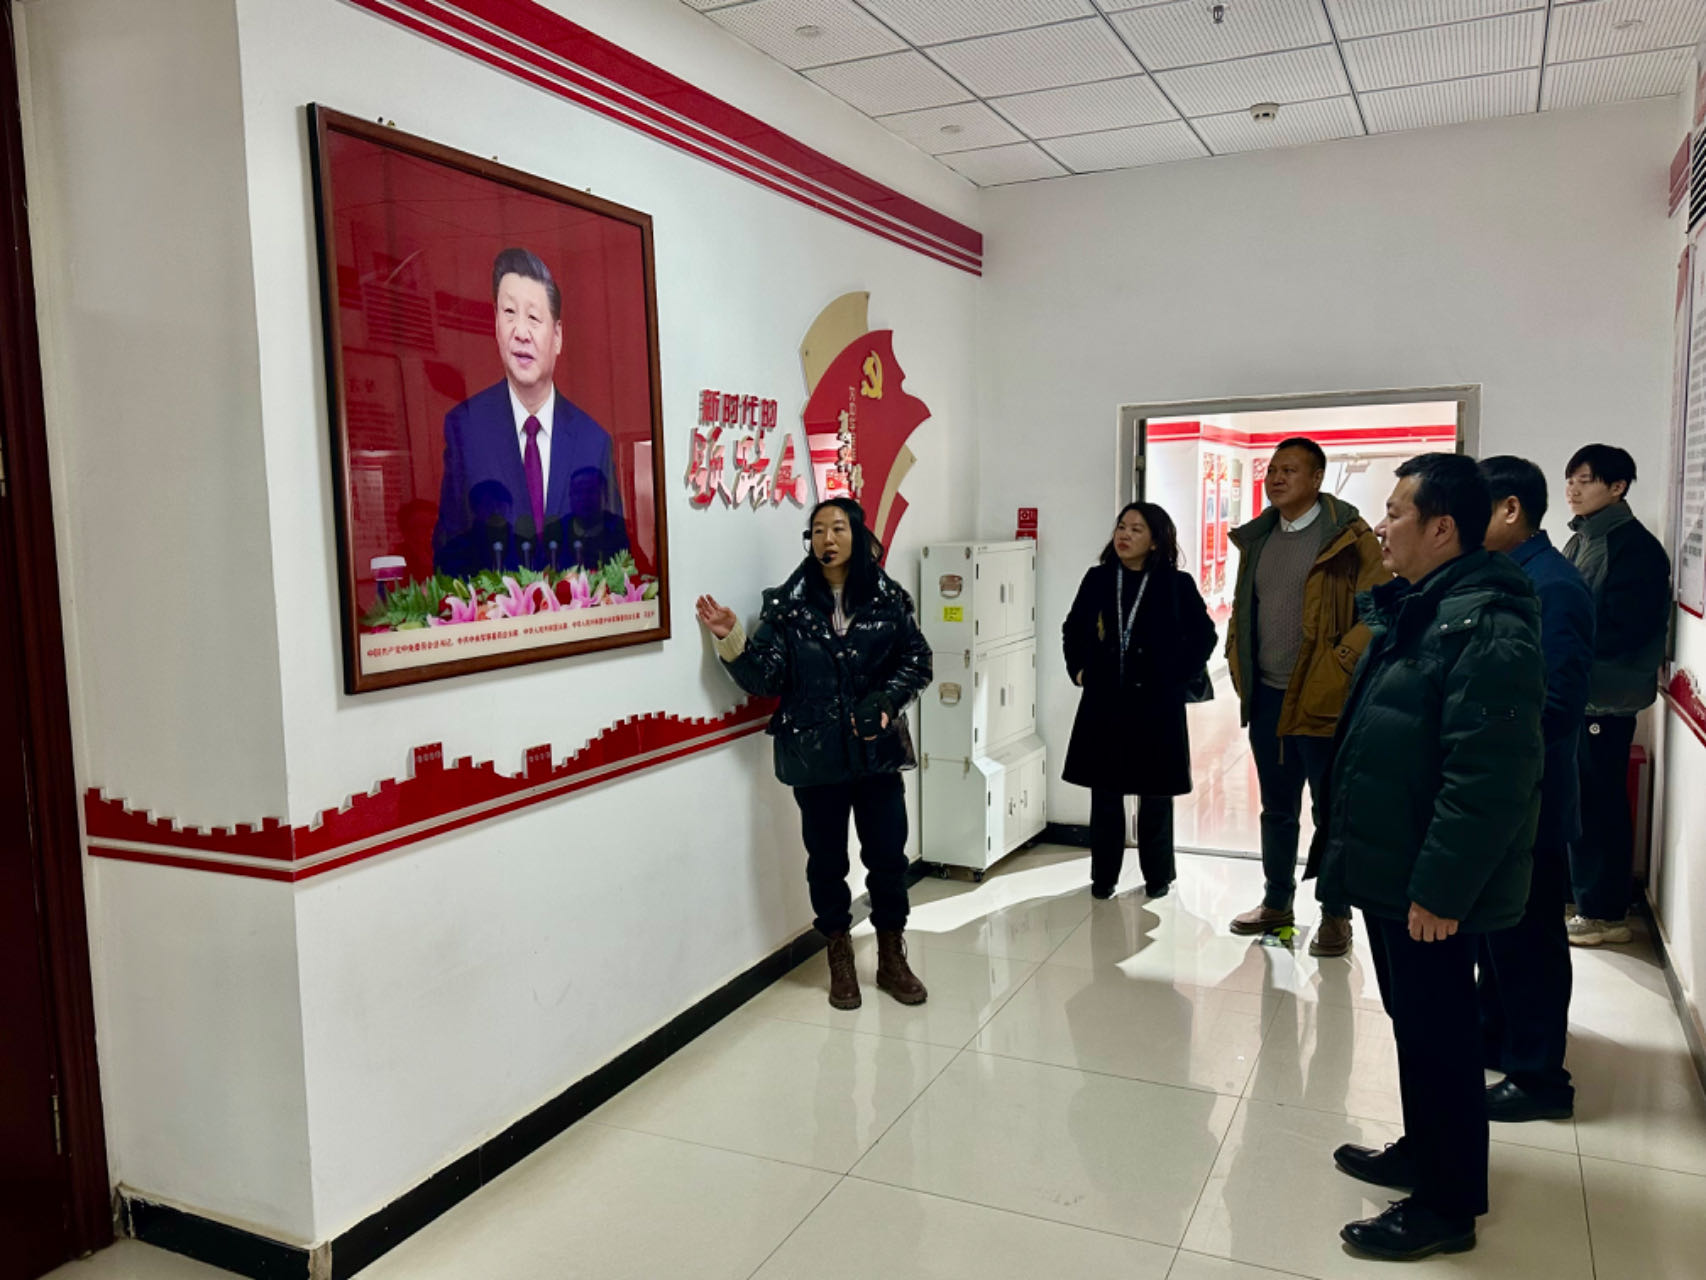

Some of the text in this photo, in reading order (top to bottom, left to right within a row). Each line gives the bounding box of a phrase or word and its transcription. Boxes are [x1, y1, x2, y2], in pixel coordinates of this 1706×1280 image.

[700, 389, 778, 429] 新时代的
[688, 427, 808, 507] 领路人
